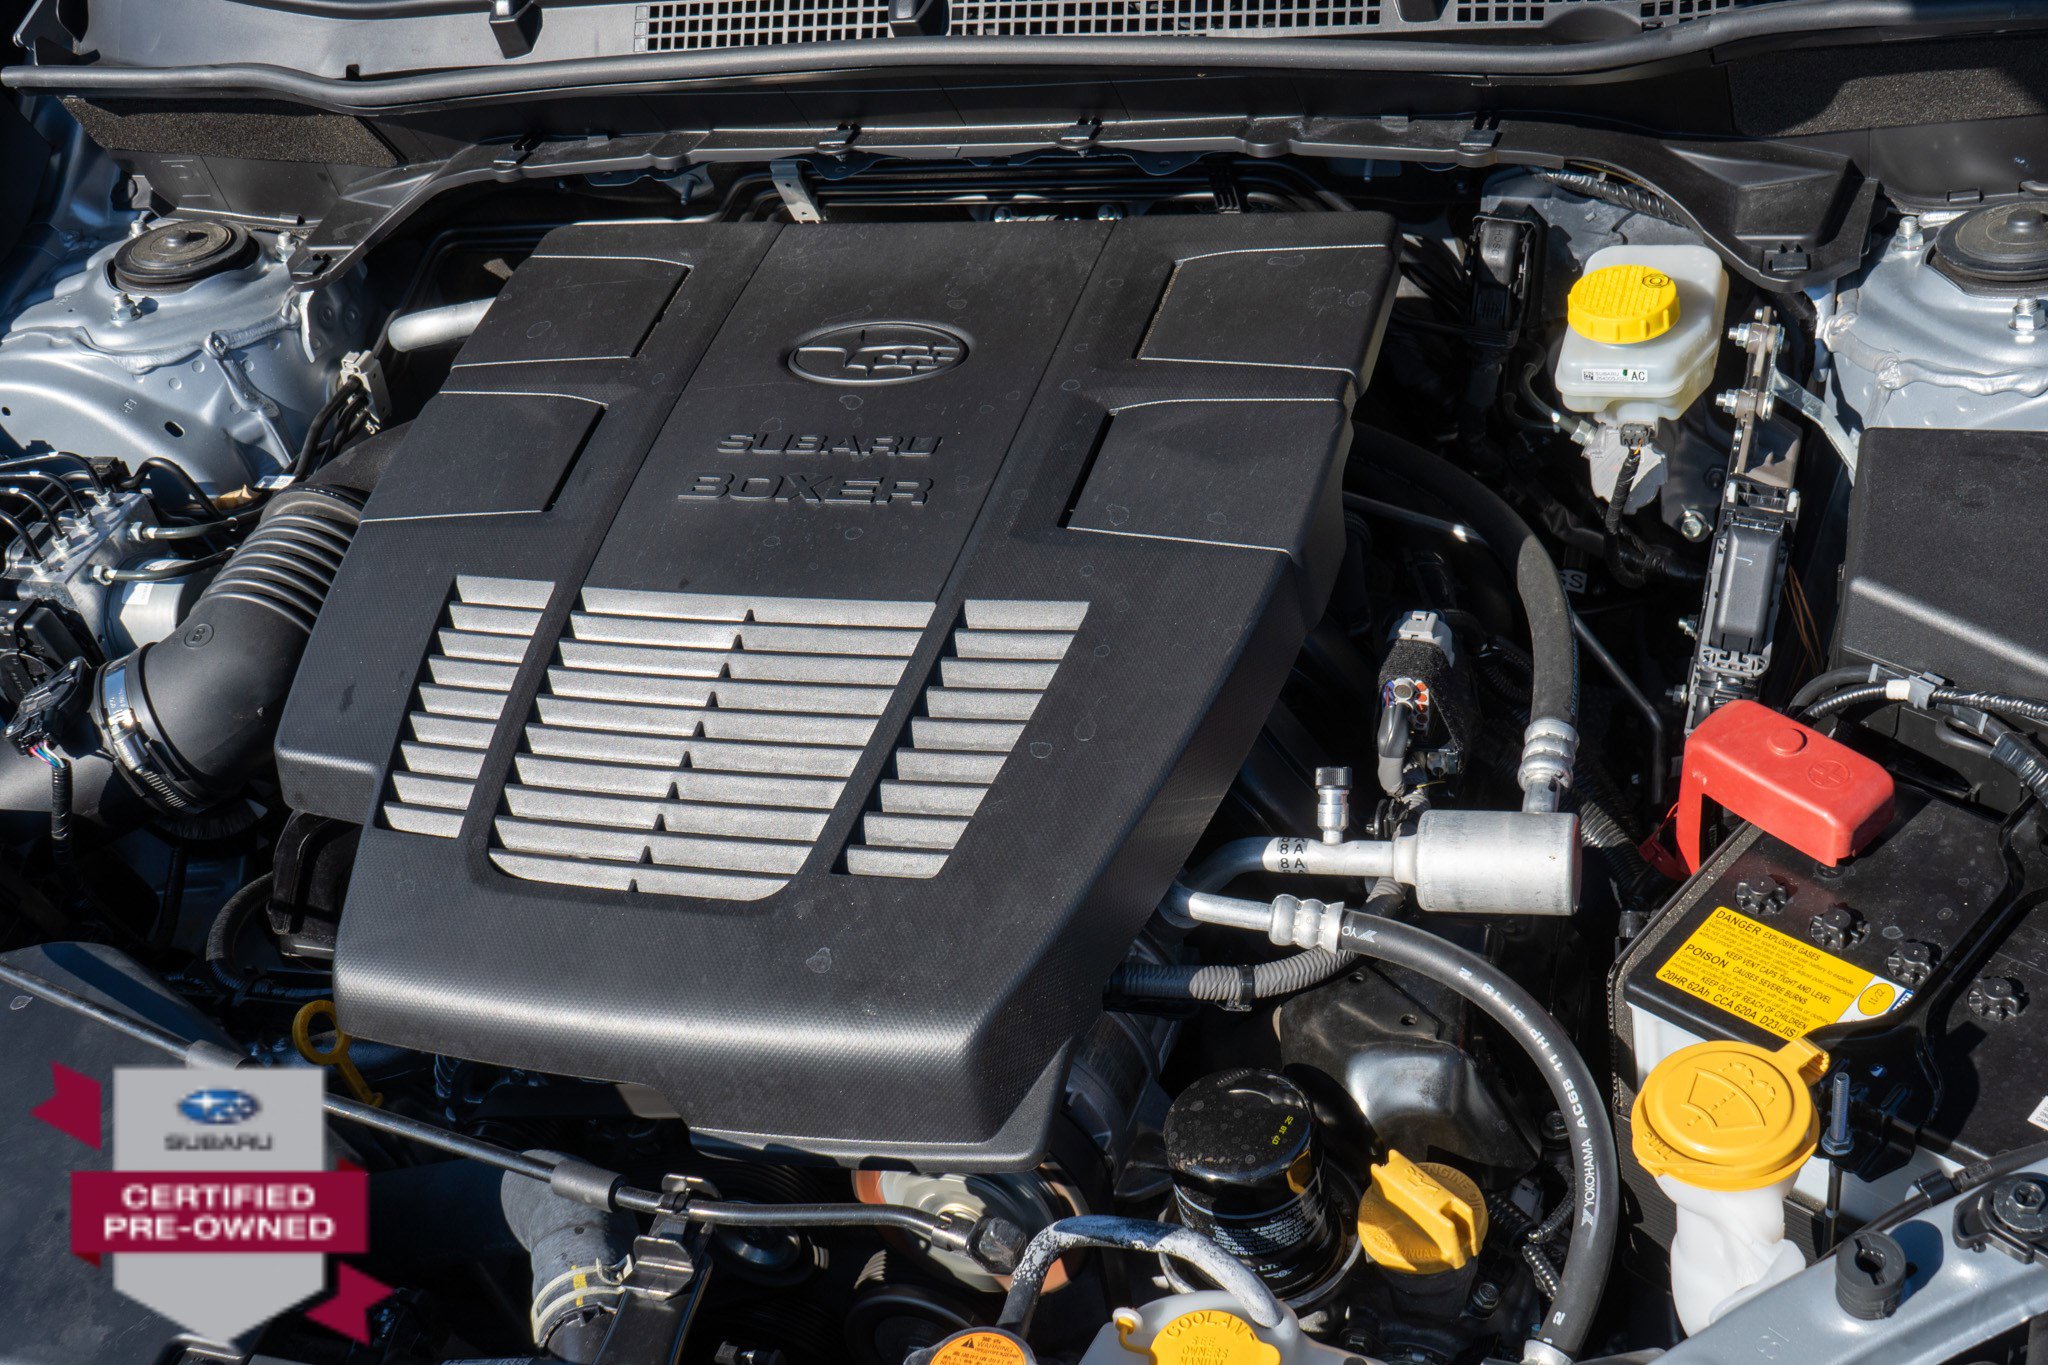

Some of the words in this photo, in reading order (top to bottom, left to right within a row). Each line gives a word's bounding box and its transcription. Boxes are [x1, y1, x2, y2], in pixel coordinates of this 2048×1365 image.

[1631, 371, 1645, 380] AC
[717, 434, 943, 458] SUBARU
[677, 473, 934, 506] BOXER
[1293, 843, 1304, 854] A
[1294, 857, 1305, 869] A
[1715, 910, 1762, 935] DANGER
[1761, 931, 1798, 951] EXPLOSIVE
[1796, 947, 1821, 961] GASES
[1661, 969, 1688, 985] 20HR
[1686, 981, 1712, 997] 62Ah
[1711, 993, 1735, 1008] CCA
[1732, 1003, 1759, 1019] 620A
[1684, 943, 1729, 968] POISON
[1731, 965, 1759, 982] CAUSES
[1757, 978, 1785, 994] SEVERE
[1782, 989, 1808, 1005] BURNS
[1723, 949, 1743, 961] KEEP
[1740, 957, 1760, 969] VENT
[1758, 965, 1778, 978] CAPS
[1776, 974, 1797, 987] TIGHT
[1795, 983, 1812, 994] AND
[1810, 989, 1833, 1003] LEVEL
[1700, 975, 1719, 987] KEEP
[1717, 984, 1732, 994] OUT
[1731, 990, 1741, 998] OF
[1740, 995, 1765, 1009] REACH
[1763, 1005, 1775, 1014] OF
[1773, 1010, 1808, 1029] CHILDREN
[1563, 1078, 1588, 1128] AC6B
[1582, 1138, 1596, 1207] YOKOHAMA
